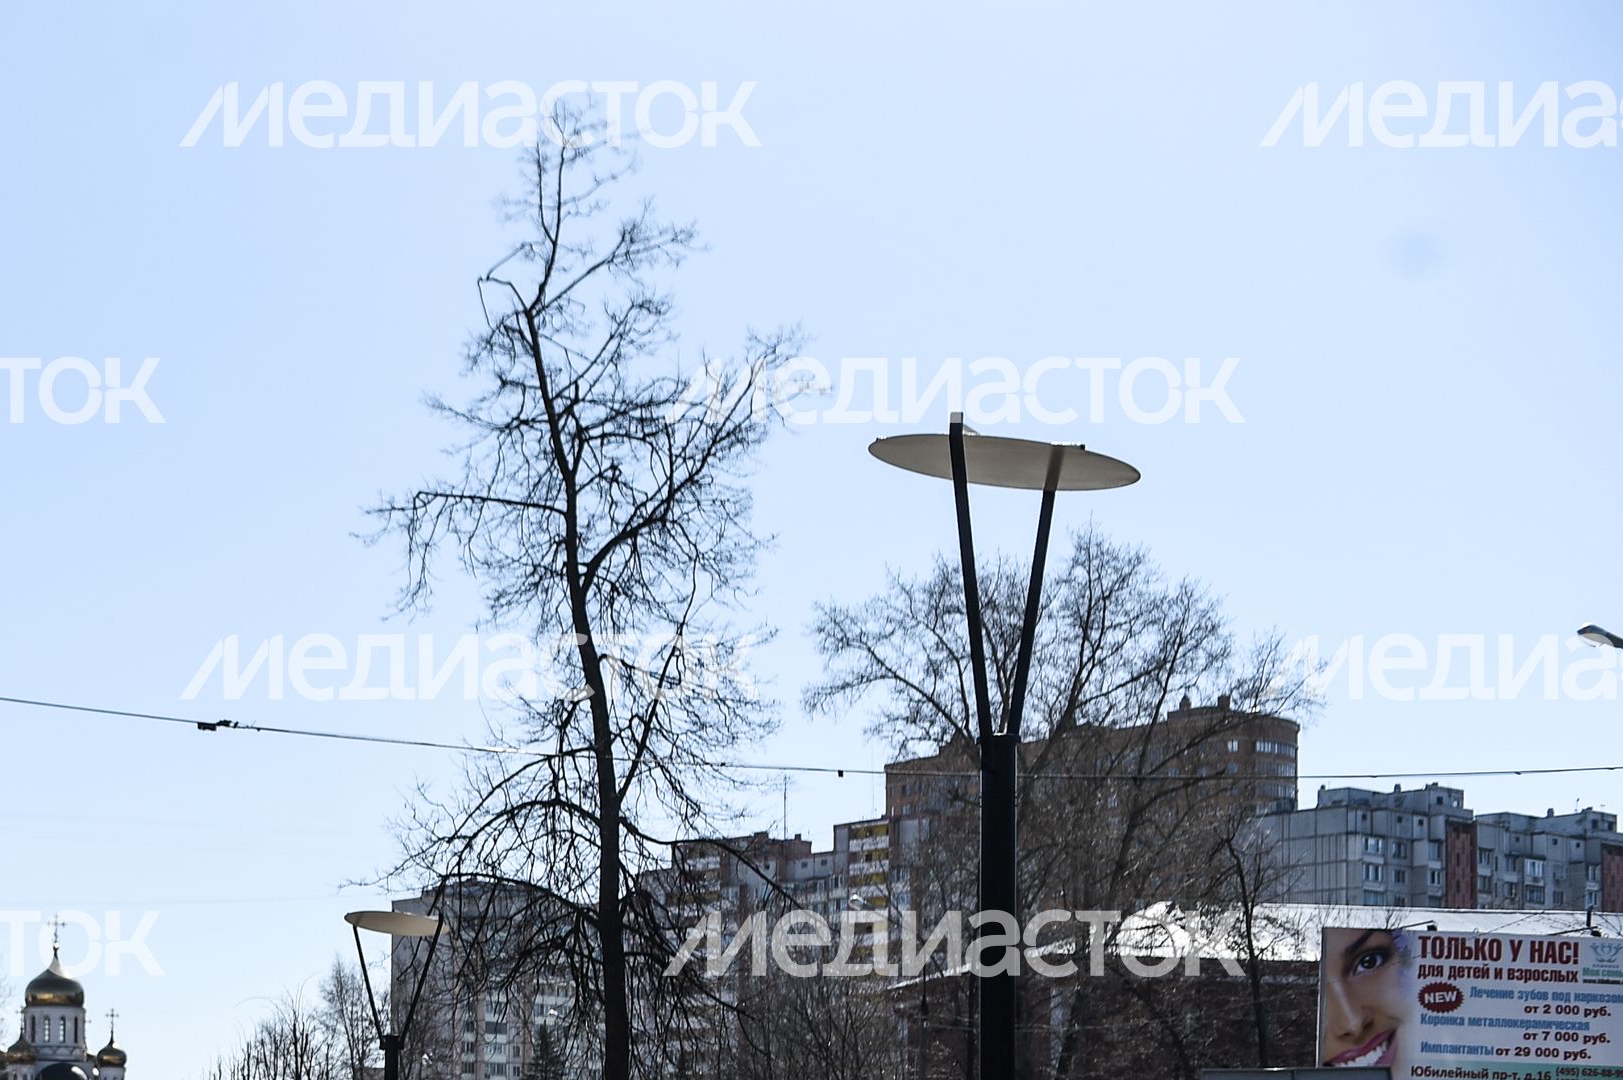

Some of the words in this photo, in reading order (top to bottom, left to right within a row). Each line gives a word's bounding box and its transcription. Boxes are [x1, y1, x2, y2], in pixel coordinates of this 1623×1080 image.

[1418, 936, 1502, 962] ТОЛЬКО
[1509, 939, 1523, 963] У
[1530, 940, 1579, 965] НАС!
[1418, 964, 1444, 980] для
[1448, 962, 1490, 980] детей
[1494, 967, 1503, 980] и
[1507, 967, 1579, 984] взрослых
[1424, 991, 1457, 1004] NEW
[1470, 986, 1515, 1000] Лечение
[1517, 988, 1549, 1002] зубов
[1551, 991, 1571, 1004] под
[1524, 1005, 1539, 1014] от
[1543, 1004, 1551, 1014] 2
[1555, 1004, 1580, 1015] 000
[1584, 1006, 1611, 1018] руб.
[1420, 1012, 1465, 1027] Коронка
[1467, 1016, 1590, 1031] металлокерамическая
[1523, 1032, 1538, 1041] от
[1542, 1031, 1550, 1041] 7
[1554, 1031, 1579, 1042] 000
[1583, 1033, 1610, 1045] руб.
[1420, 1041, 1494, 1056] Имплантанты
[1495, 1047, 1510, 1056] от
[1514, 1046, 1531, 1057] 29
[1535, 1047, 1559, 1058] 000
[1564, 1049, 1591, 1061] руб.
[1411, 1065, 1489, 1080] Юбилейный
[1556, 1066, 1579, 1078] (495)
